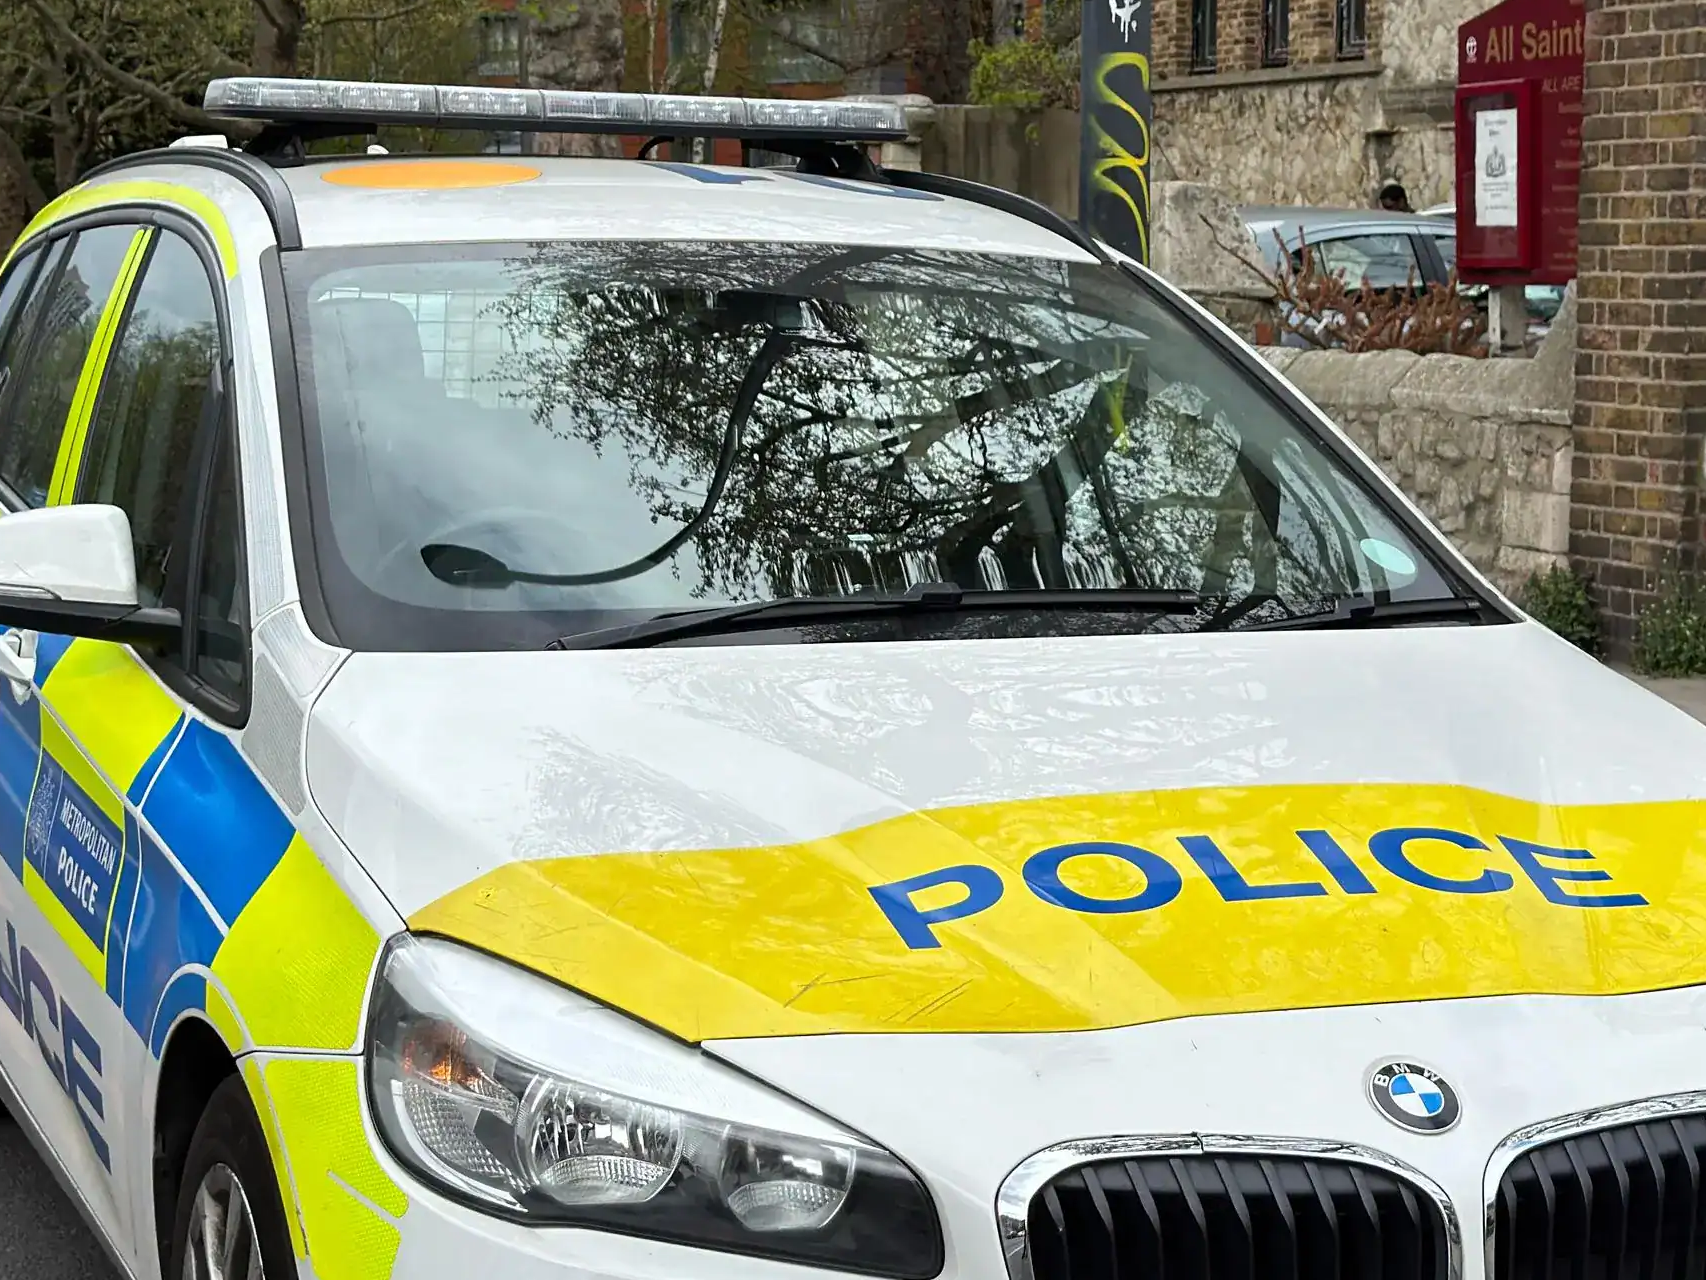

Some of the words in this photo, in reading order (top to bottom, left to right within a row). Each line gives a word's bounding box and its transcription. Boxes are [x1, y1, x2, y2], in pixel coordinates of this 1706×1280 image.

[1485, 25, 1514, 63] All
[59, 797, 118, 876] METROPOLITAN
[57, 846, 99, 916] POLICE
[866, 825, 1651, 952] POLICE
[1373, 1062, 1441, 1087] BMW
